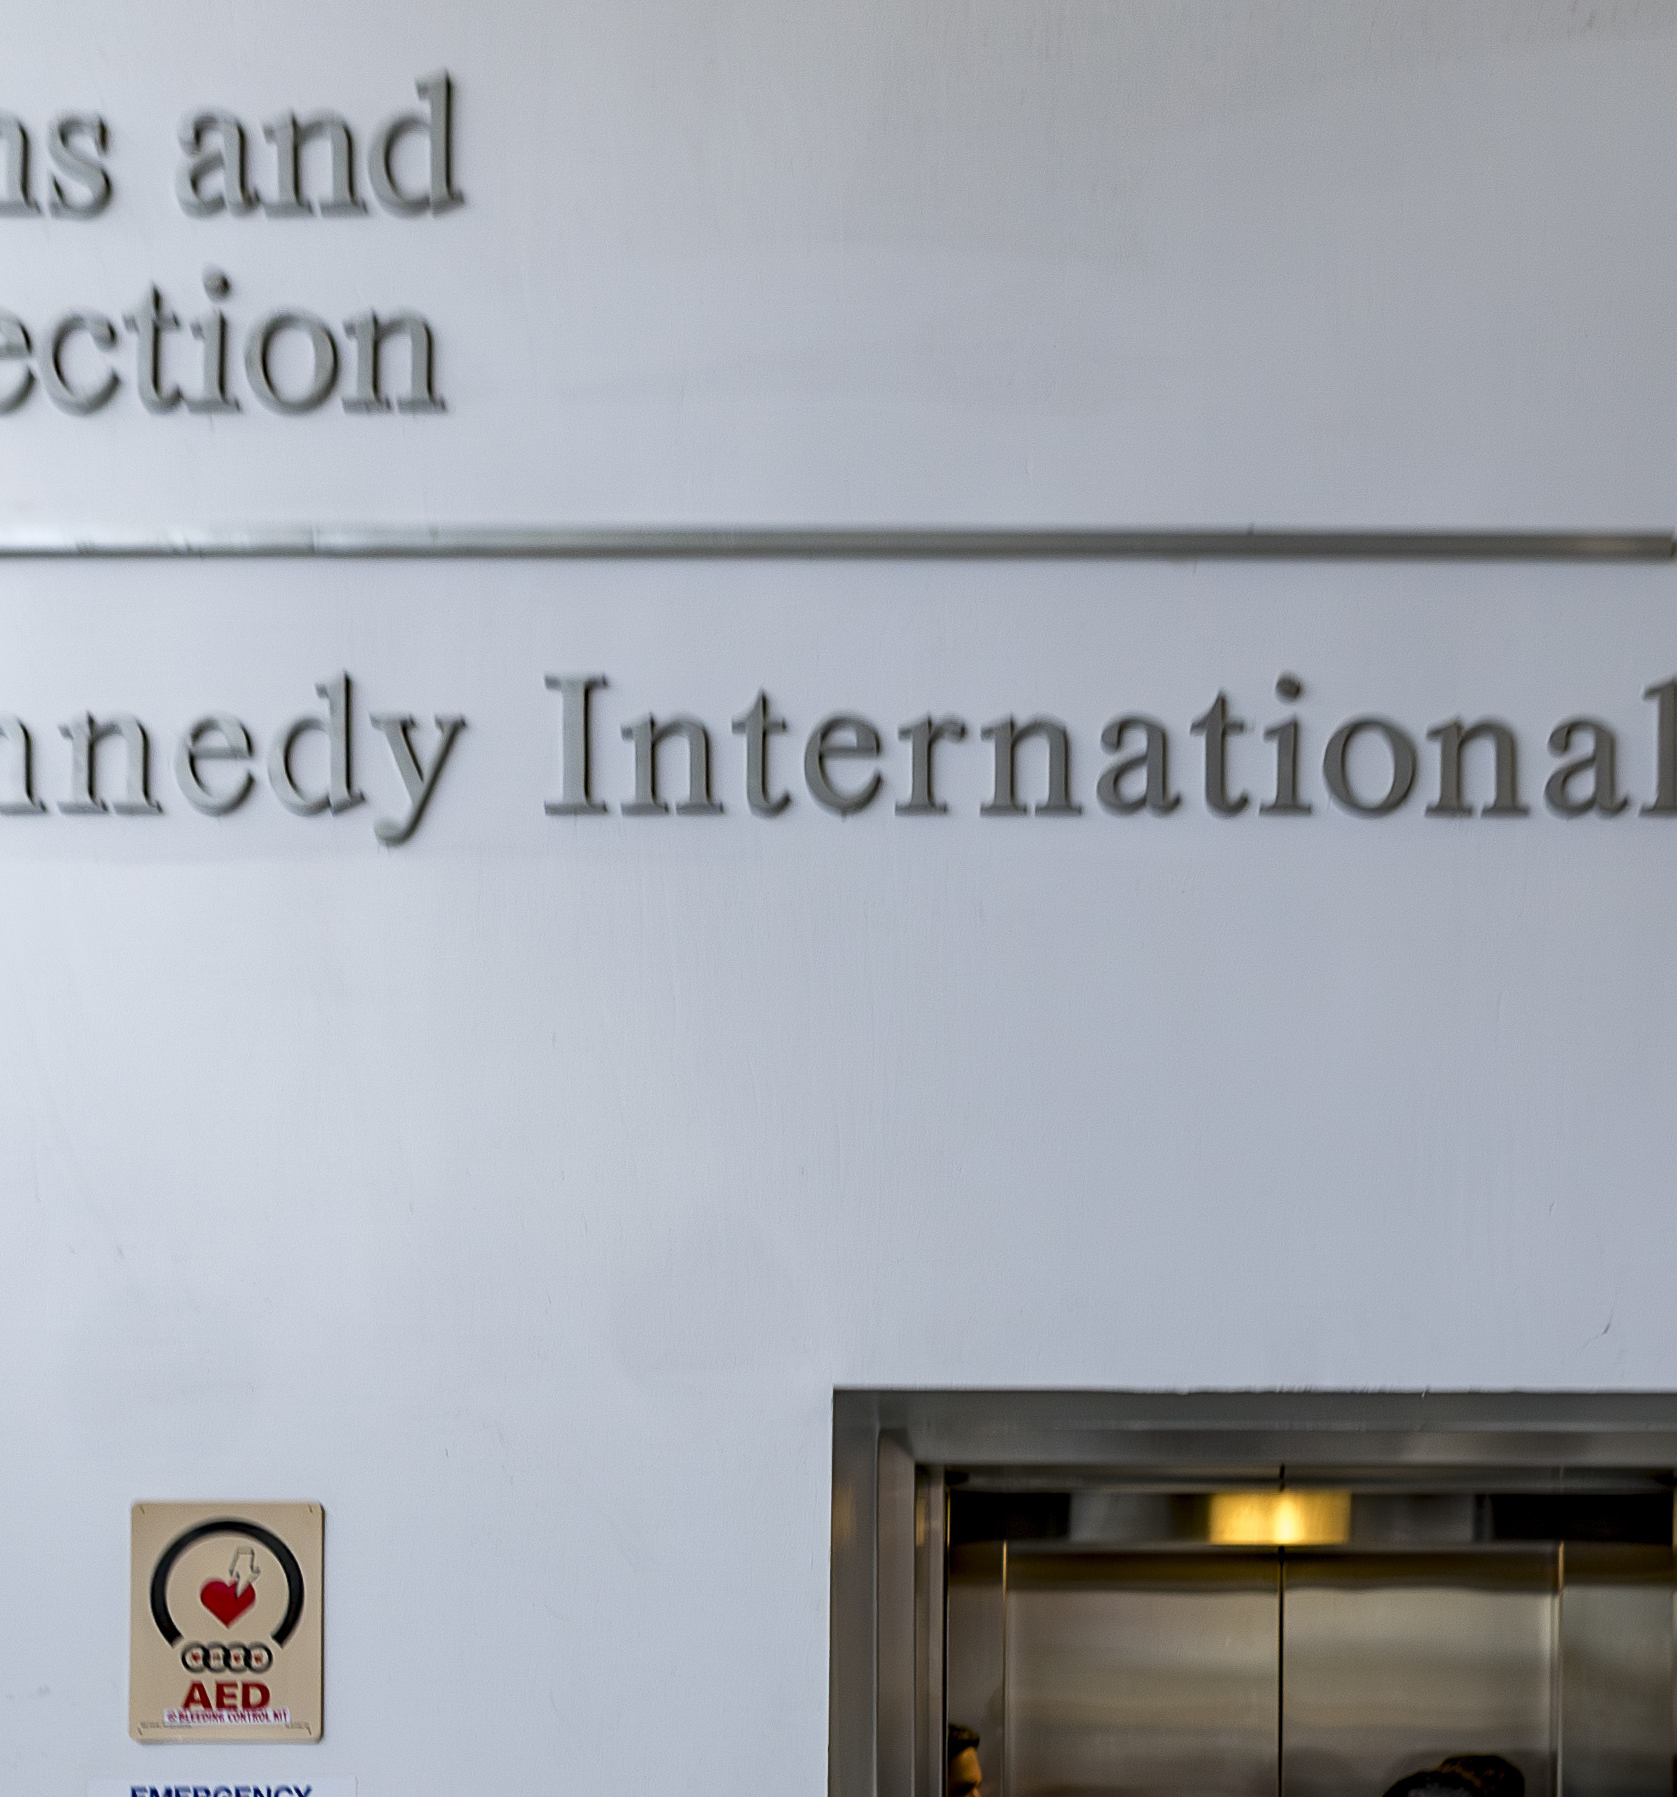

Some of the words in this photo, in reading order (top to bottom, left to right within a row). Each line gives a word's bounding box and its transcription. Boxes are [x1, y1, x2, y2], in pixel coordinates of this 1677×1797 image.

[177, 71, 465, 219] and
[182, 1682, 271, 1711] AED
[227, 1710, 271, 1723] CONTROL
[273, 1709, 288, 1723] KIT
